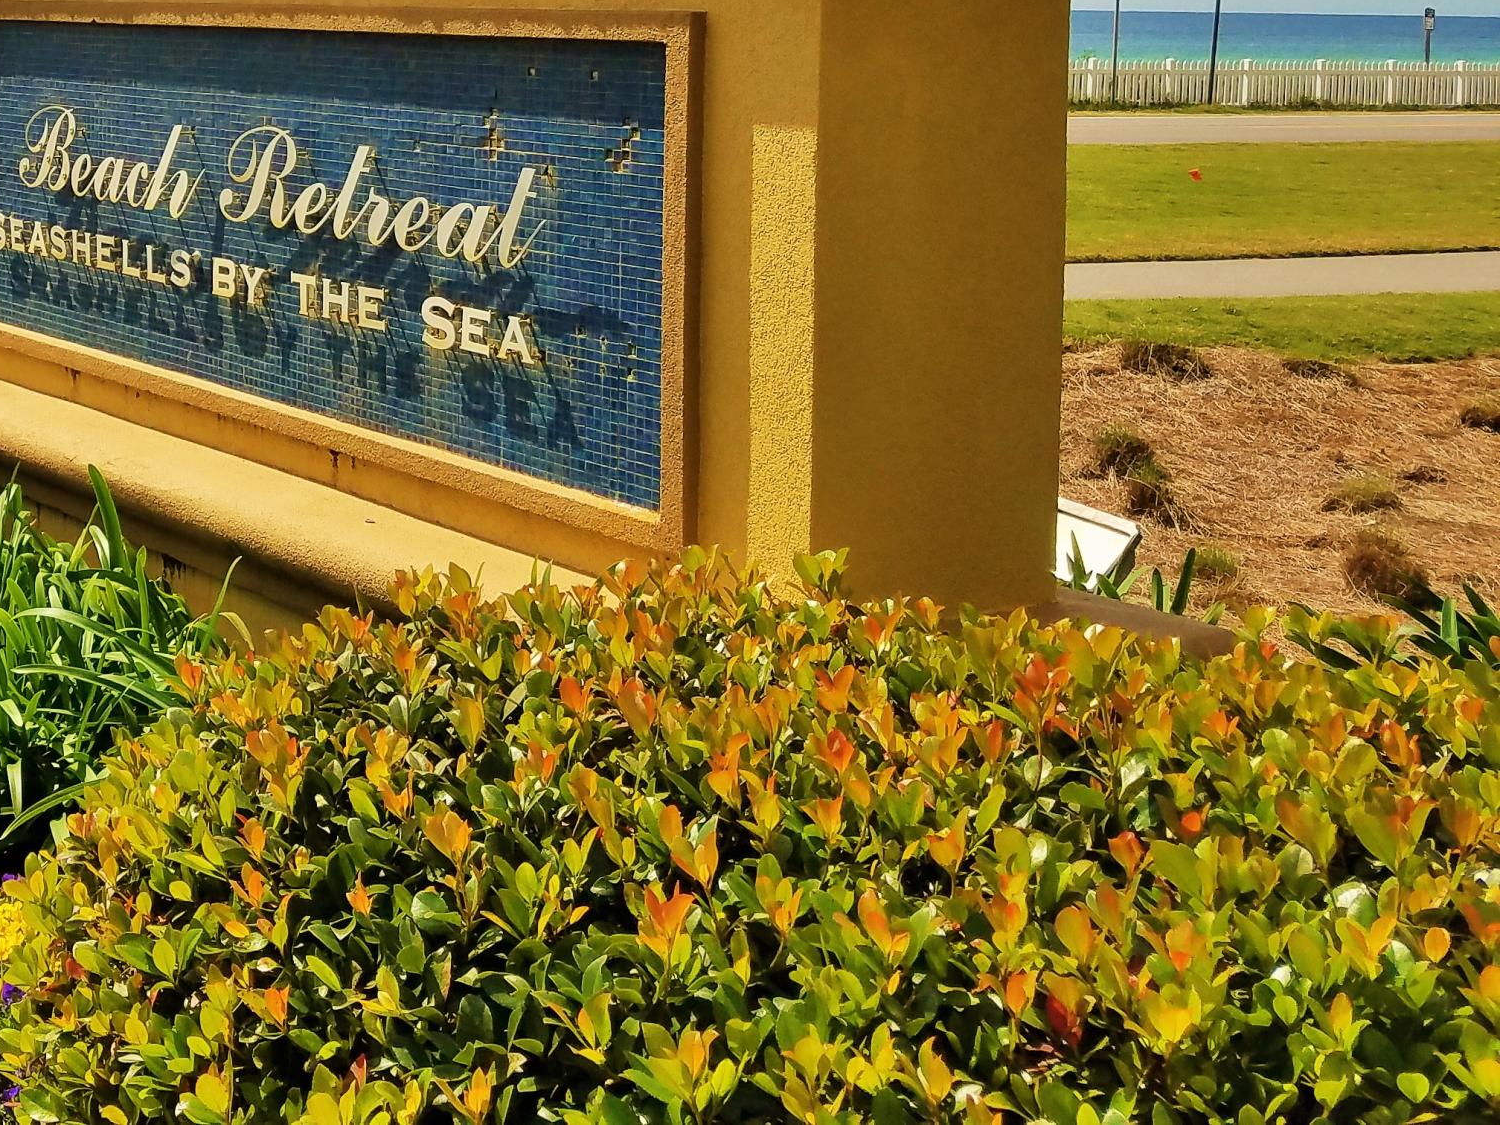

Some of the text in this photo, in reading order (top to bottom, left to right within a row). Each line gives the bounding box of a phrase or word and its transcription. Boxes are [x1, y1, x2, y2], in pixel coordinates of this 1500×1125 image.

[19, 105, 547, 269] Beach Retreat
[212, 257, 266, 304] BY
[290, 271, 387, 332] THE
[421, 296, 535, 365] SEA
